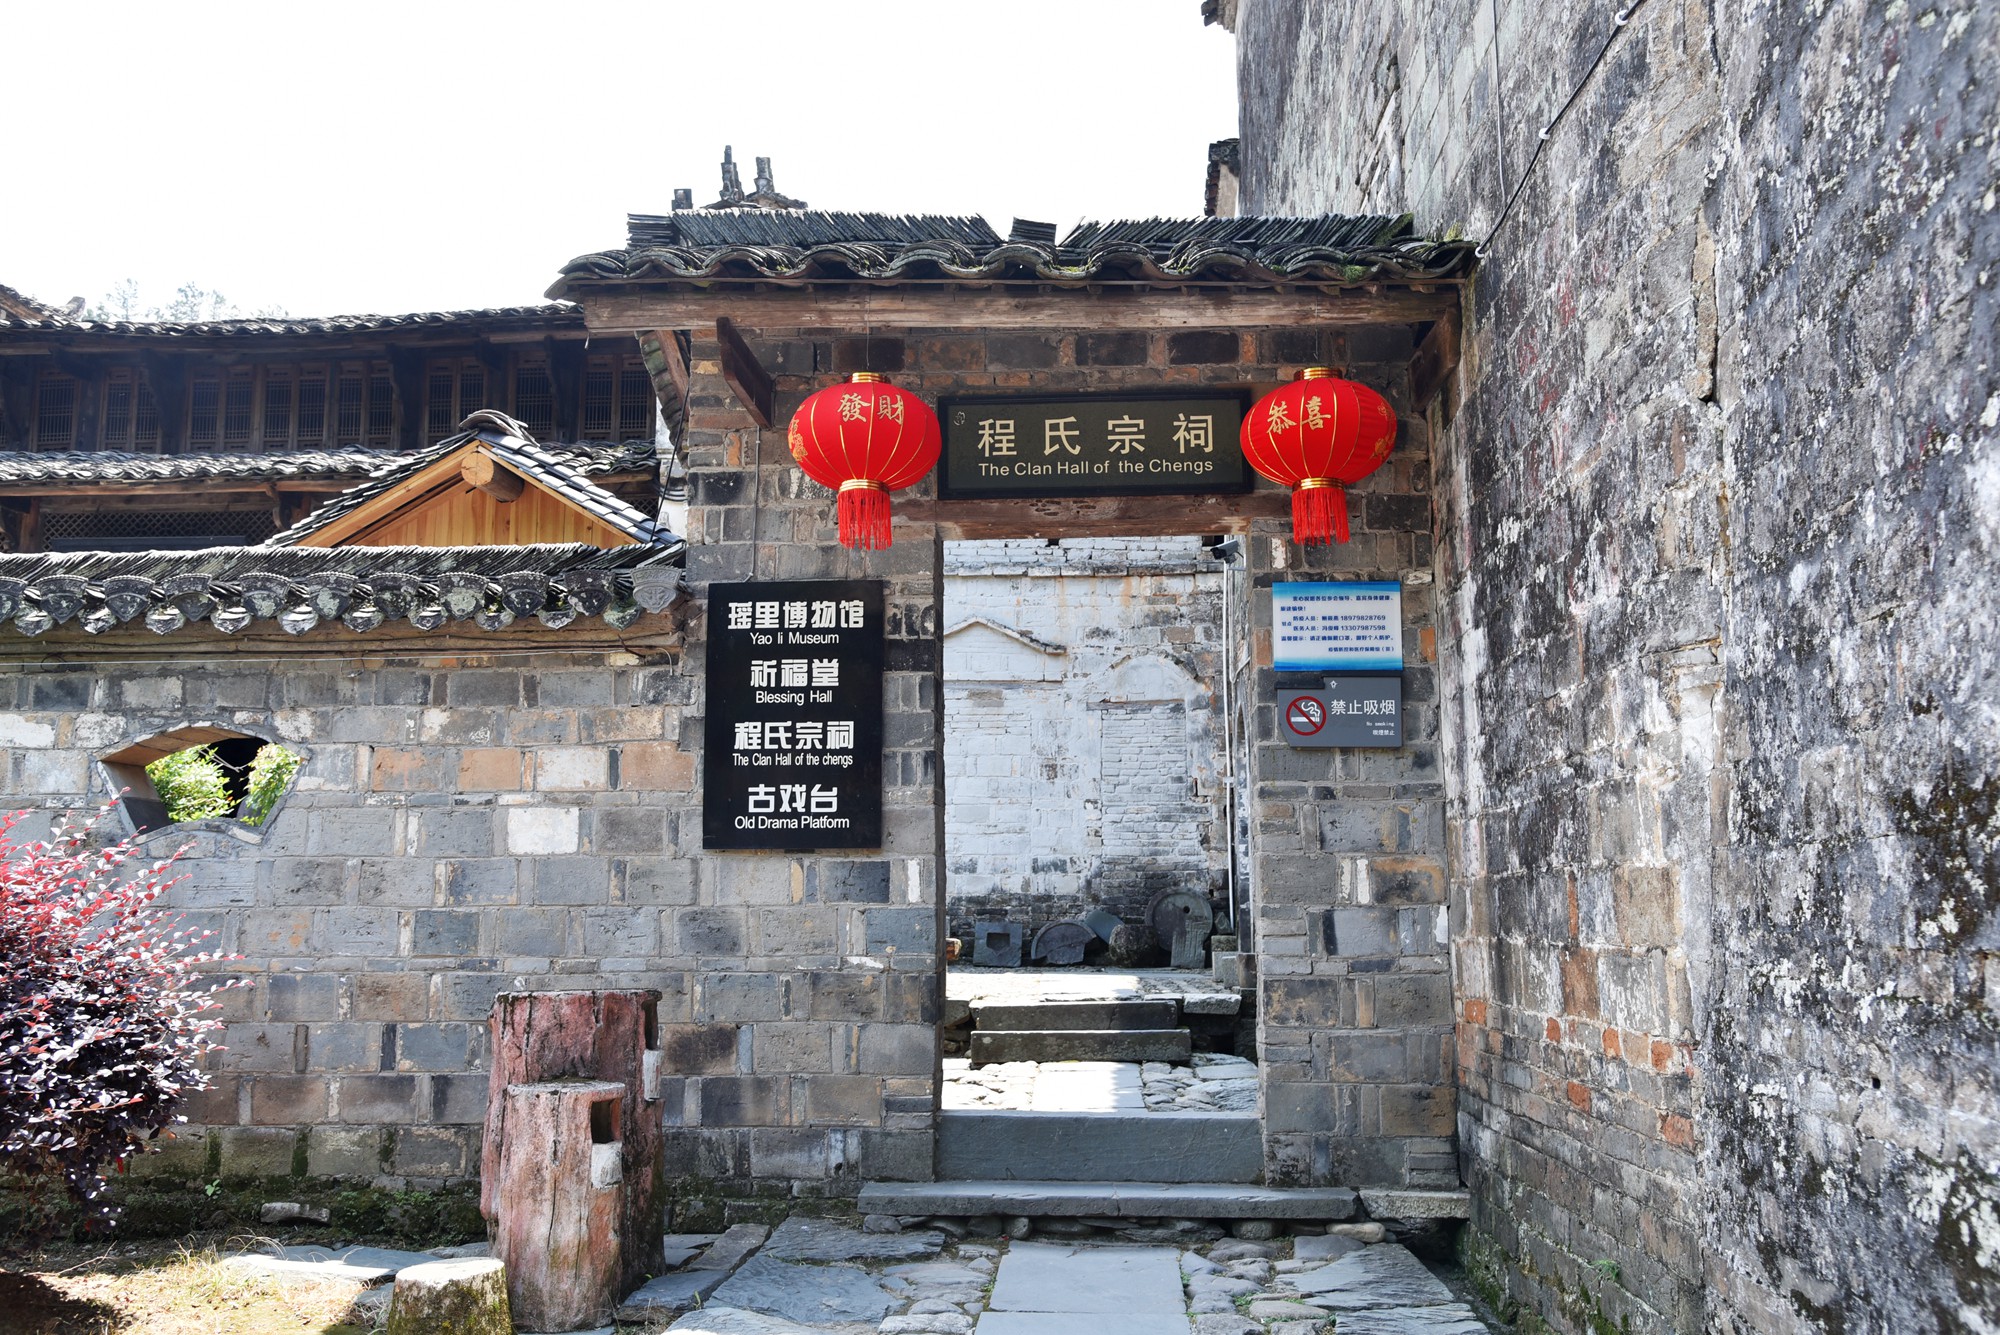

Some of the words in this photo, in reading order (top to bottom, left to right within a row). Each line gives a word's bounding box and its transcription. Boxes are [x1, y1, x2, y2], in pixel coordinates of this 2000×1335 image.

[837, 392, 905, 425] 發財
[1266, 395, 1332, 435] 恭喜
[977, 412, 1214, 457] 程氏宗祠
[978, 463, 1010, 477] The
[1014, 462, 1052, 475] Clan
[1057, 461, 1089, 474] Hall
[1093, 460, 1110, 474] of
[1118, 460, 1144, 473] the
[1149, 458, 1214, 474] Chengs
[727, 599, 865, 630] 瑶里博物馆
[750, 632, 773, 645] Yao
[788, 632, 840, 644] Museum
[750, 658, 840, 688] 祈福堂
[755, 690, 805, 706] Blessing
[810, 690, 833, 703] Hall
[1331, 699, 1396, 715] 禁止吸烟
[733, 720, 855, 750] 程氏宗祠
[732, 753, 749, 766] The
[752, 753, 772, 766] Clan
[775, 752, 792, 766] Hall
[794, 752, 804, 766] of
[805, 752, 819, 766] the
[822, 752, 853, 769] chengs
[747, 783, 839, 813] 古戏台
[734, 816, 756, 829] Old
[758, 816, 798, 829] Drama
[801, 816, 850, 829] Platform
